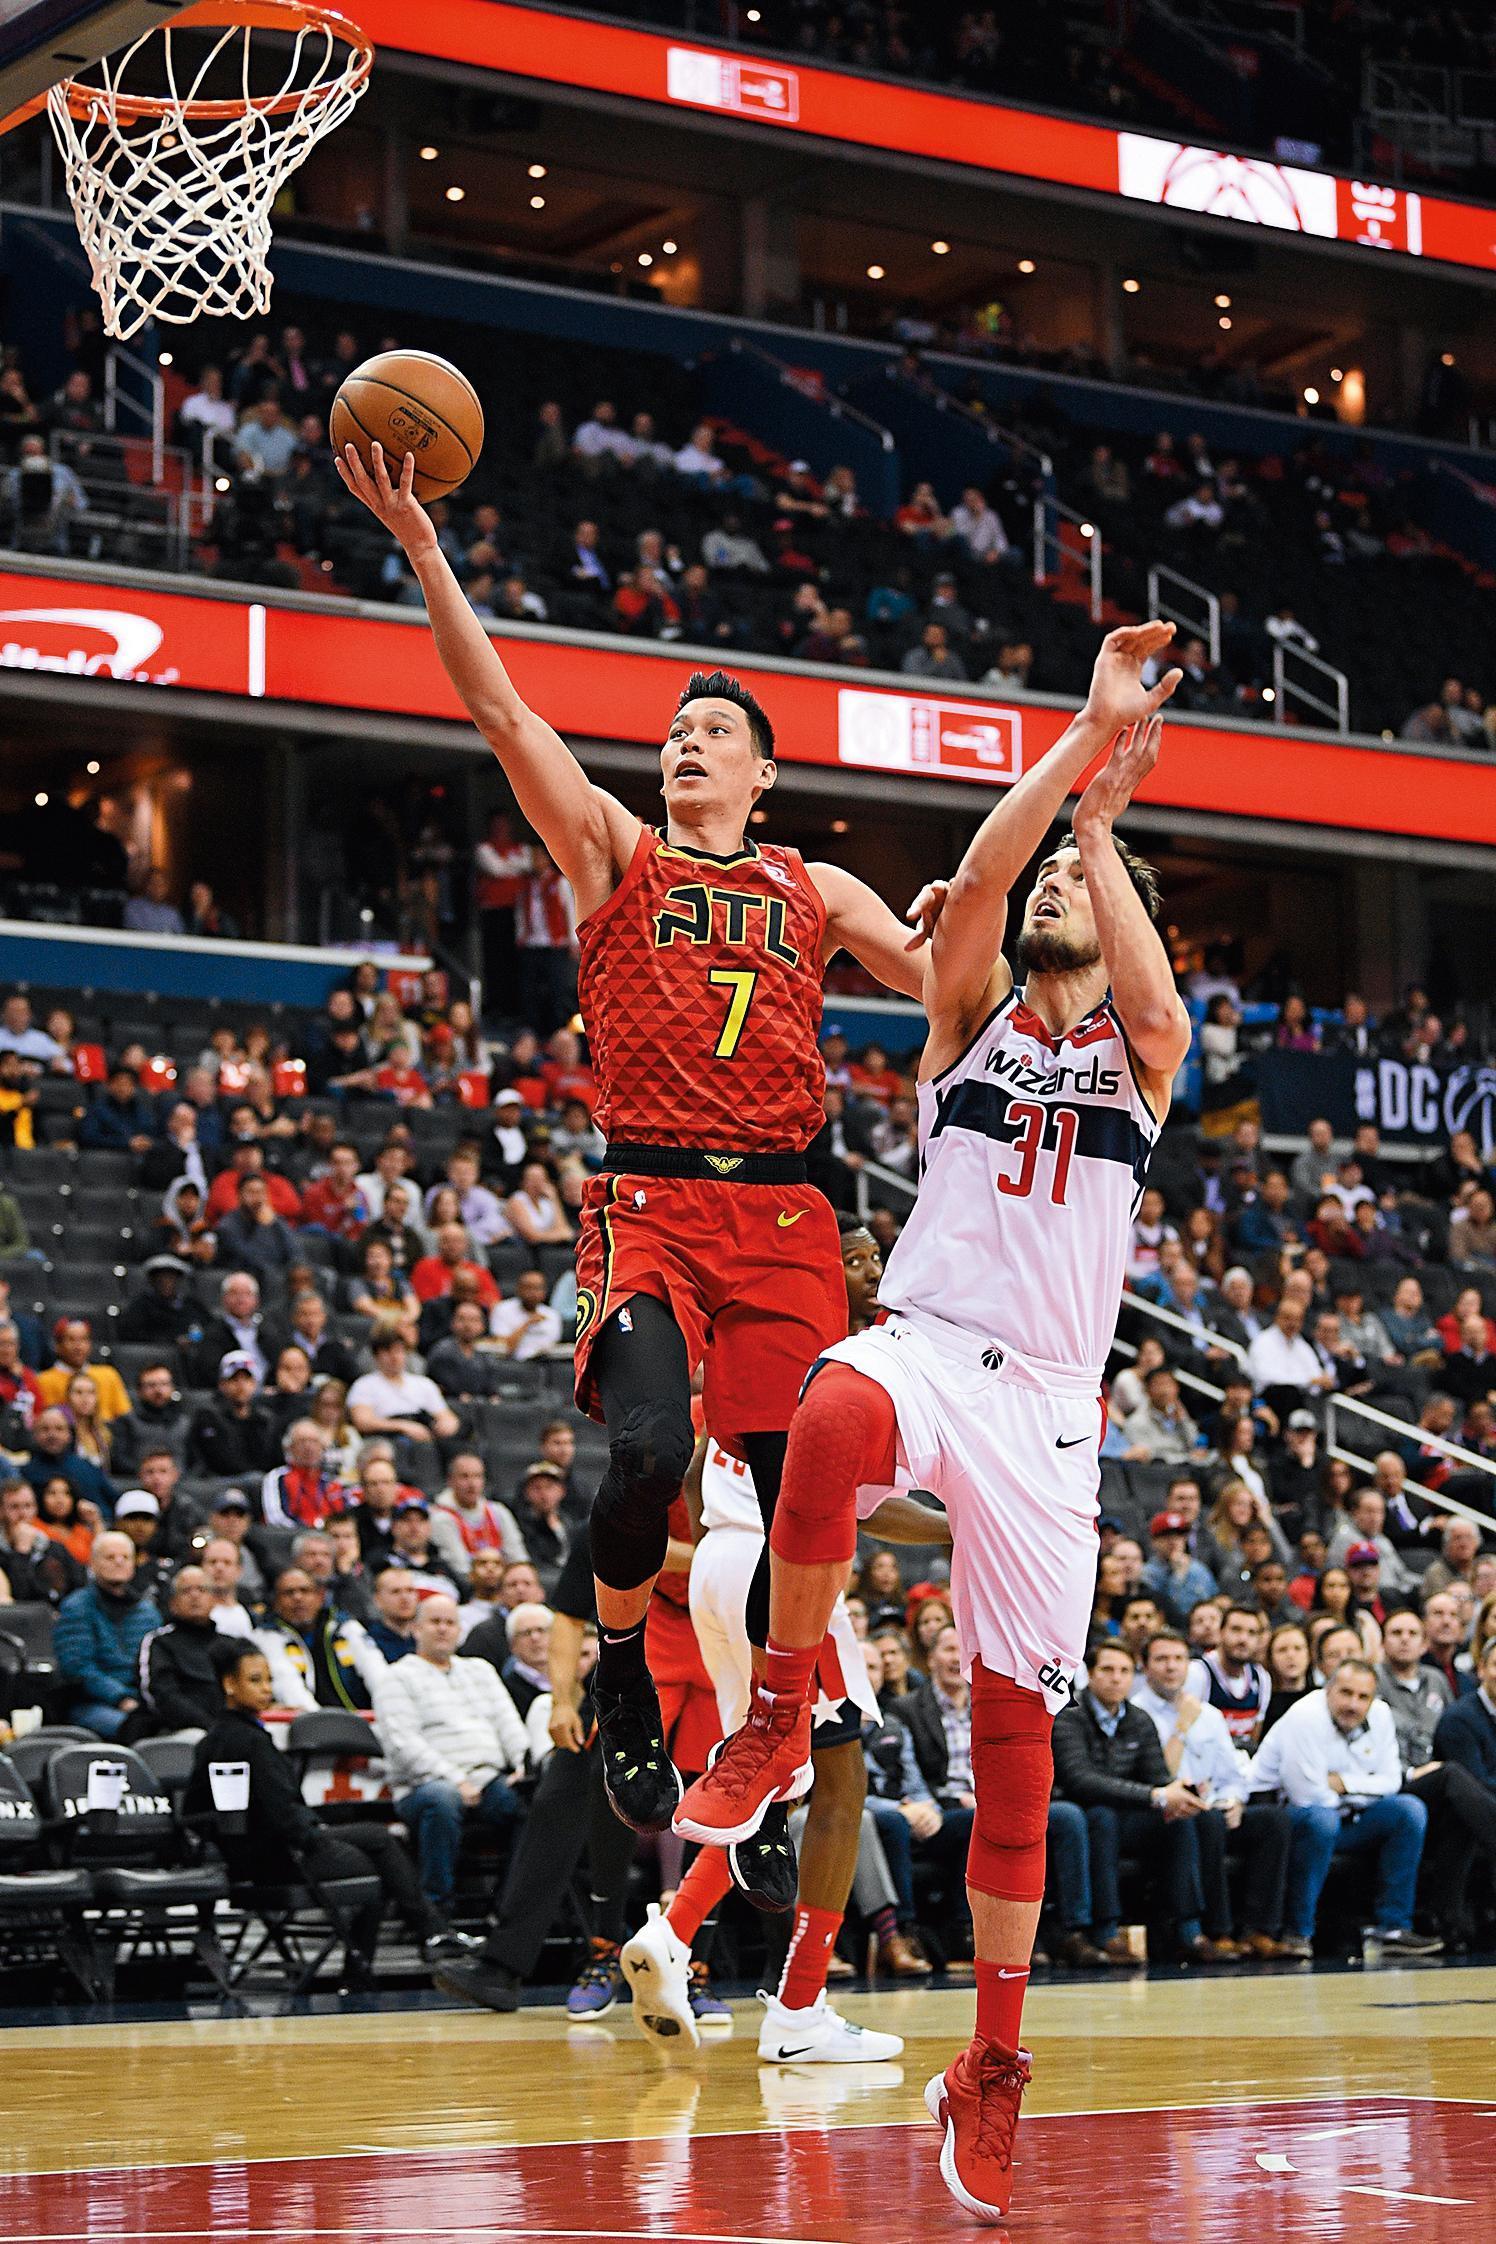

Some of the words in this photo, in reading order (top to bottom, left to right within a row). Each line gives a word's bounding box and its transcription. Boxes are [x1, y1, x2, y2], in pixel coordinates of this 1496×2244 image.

[653, 884, 801, 969] ATL
[709, 967, 759, 1059] 7
[997, 1100, 1080, 1208] 31
